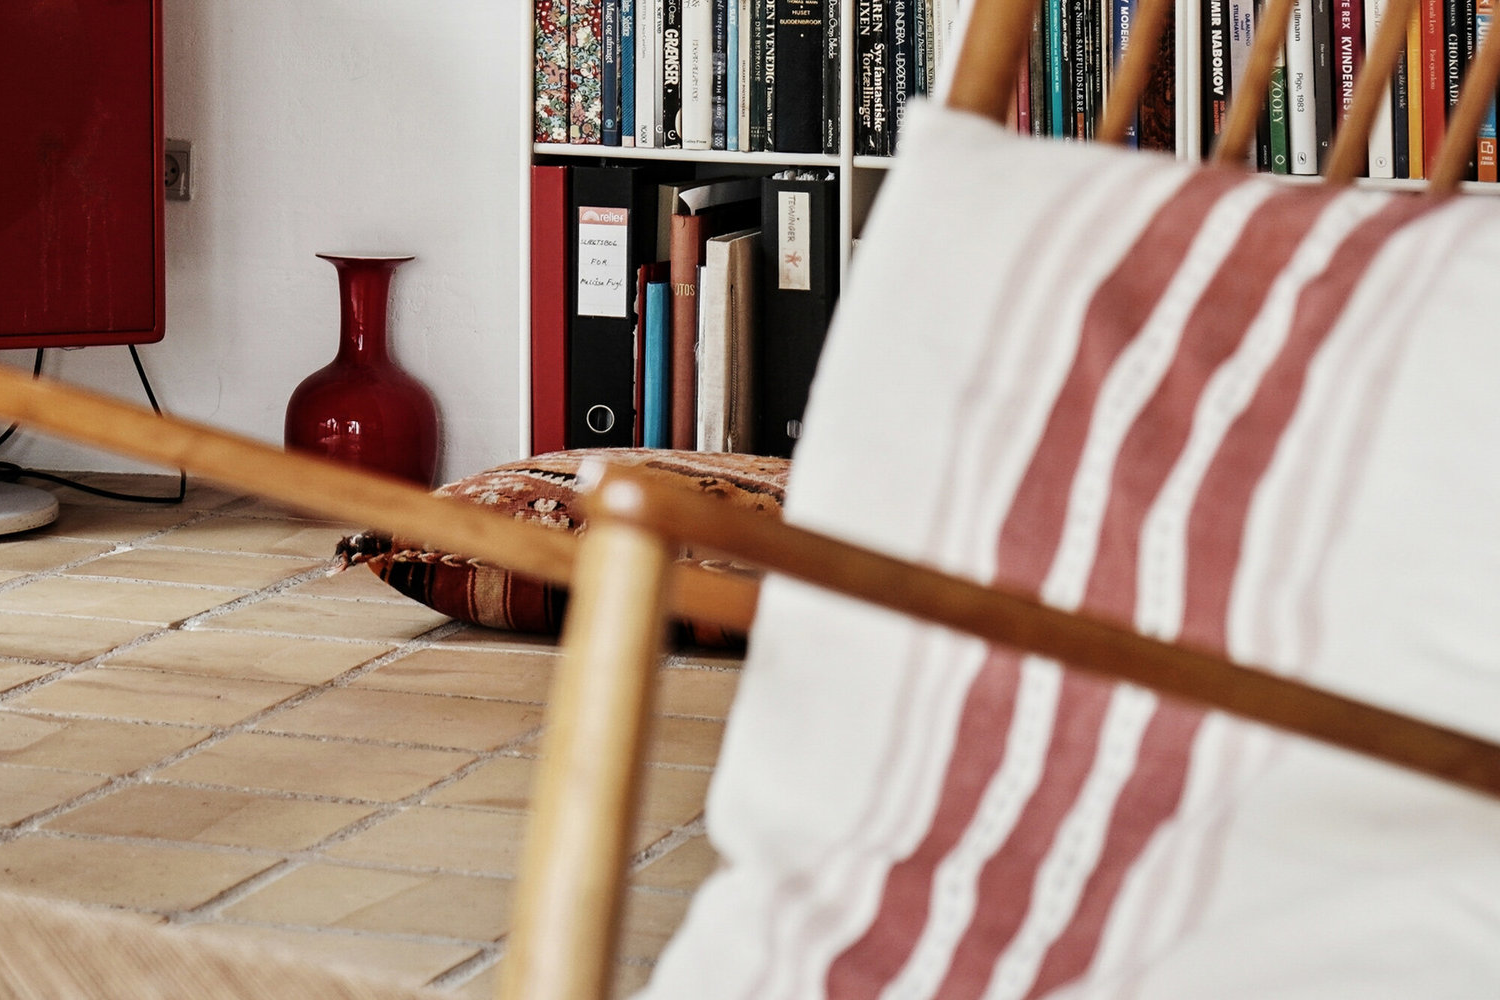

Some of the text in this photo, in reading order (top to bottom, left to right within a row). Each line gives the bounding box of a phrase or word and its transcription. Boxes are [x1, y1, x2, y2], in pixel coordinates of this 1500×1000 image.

[605, 2, 616, 20] Magt
[668, 6, 676, 24] Oates
[828, 0, 837, 18] Dorian
[1074, 2, 1082, 11] og
[1342, 11, 1350, 29] REX
[604, 21, 613, 33] og
[623, 16, 632, 36] Solstice
[827, 19, 837, 37] Grays
[896, 2, 905, 45] KUNDERA
[916, 20, 924, 37] Emily
[1075, 12, 1083, 37] Nissen:
[1120, 6, 1129, 51] MODERN
[604, 34, 615, 63] afmagt
[665, 29, 678, 85] GRÆNSER
[766, 33, 775, 84] VENEDIG
[828, 38, 837, 59] Billede
[1212, 30, 1223, 96] NABOKOV
[1076, 39, 1084, 112] SAMFUNDSLÆRE
[1341, 36, 1352, 110] KVINDERNES
[1448, 34, 1458, 106] CHOKOLADE
[860, 53, 873, 128] fortællinger
[869, 43, 885, 132] Syv fantastiske
[896, 52, 906, 132] UDØDELIGHEDEN
[1272, 80, 1284, 125] ZOOEY
[600, 212, 624, 223] relief
